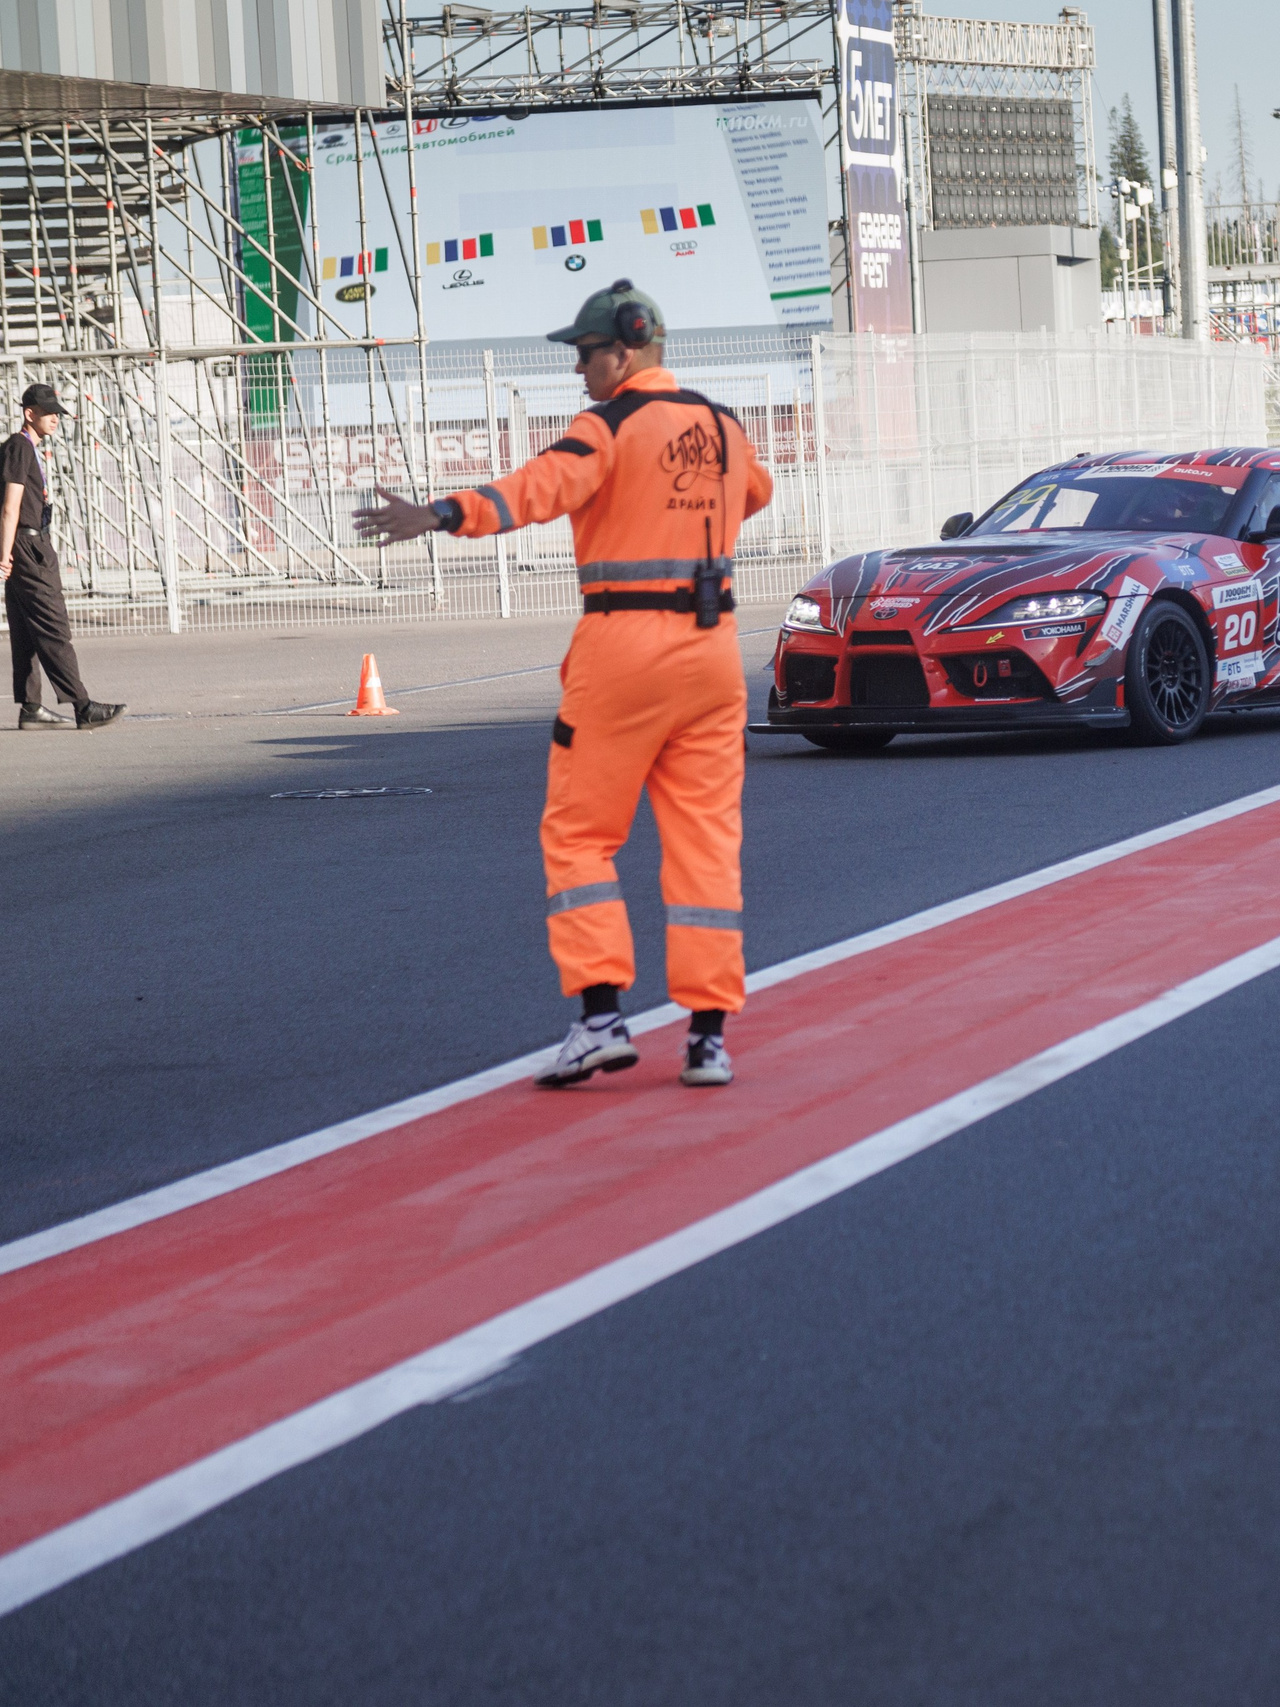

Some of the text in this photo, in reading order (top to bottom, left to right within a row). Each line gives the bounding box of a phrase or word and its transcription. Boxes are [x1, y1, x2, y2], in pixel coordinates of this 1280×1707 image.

[1173, 467, 1213, 477] auto.ru
[666, 496, 716, 510] ДРАЙВ
[1115, 583, 1141, 629] MARSHALL
[1041, 624, 1082, 636] YOKOHAMA
[1223, 610, 1257, 651] 20
